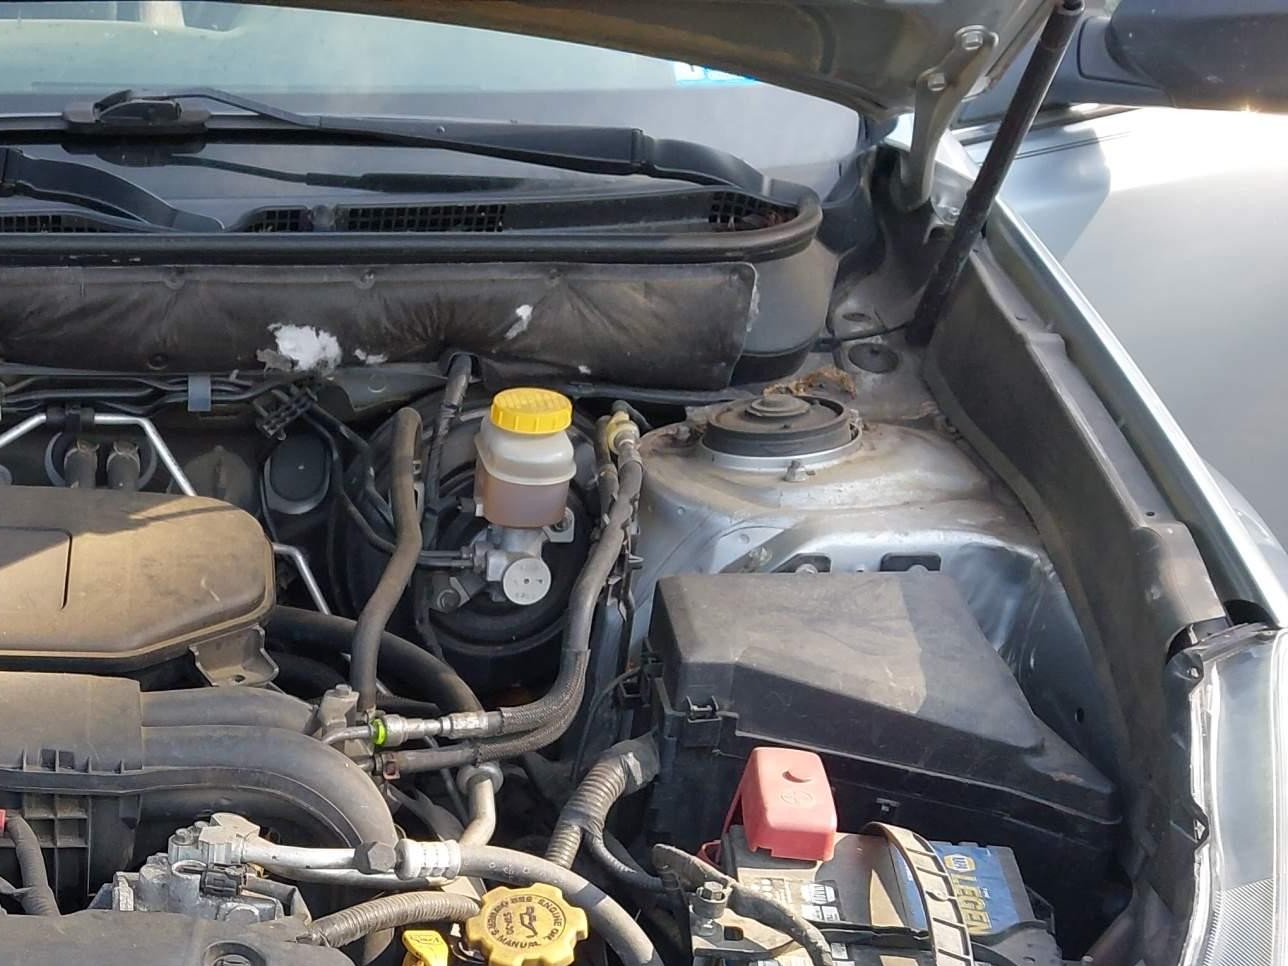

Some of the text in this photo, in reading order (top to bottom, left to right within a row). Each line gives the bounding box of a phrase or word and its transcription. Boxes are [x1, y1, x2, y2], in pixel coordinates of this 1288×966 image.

[537, 898, 562, 942] ENGINE OIL
[497, 934, 542, 949] MANUAL
